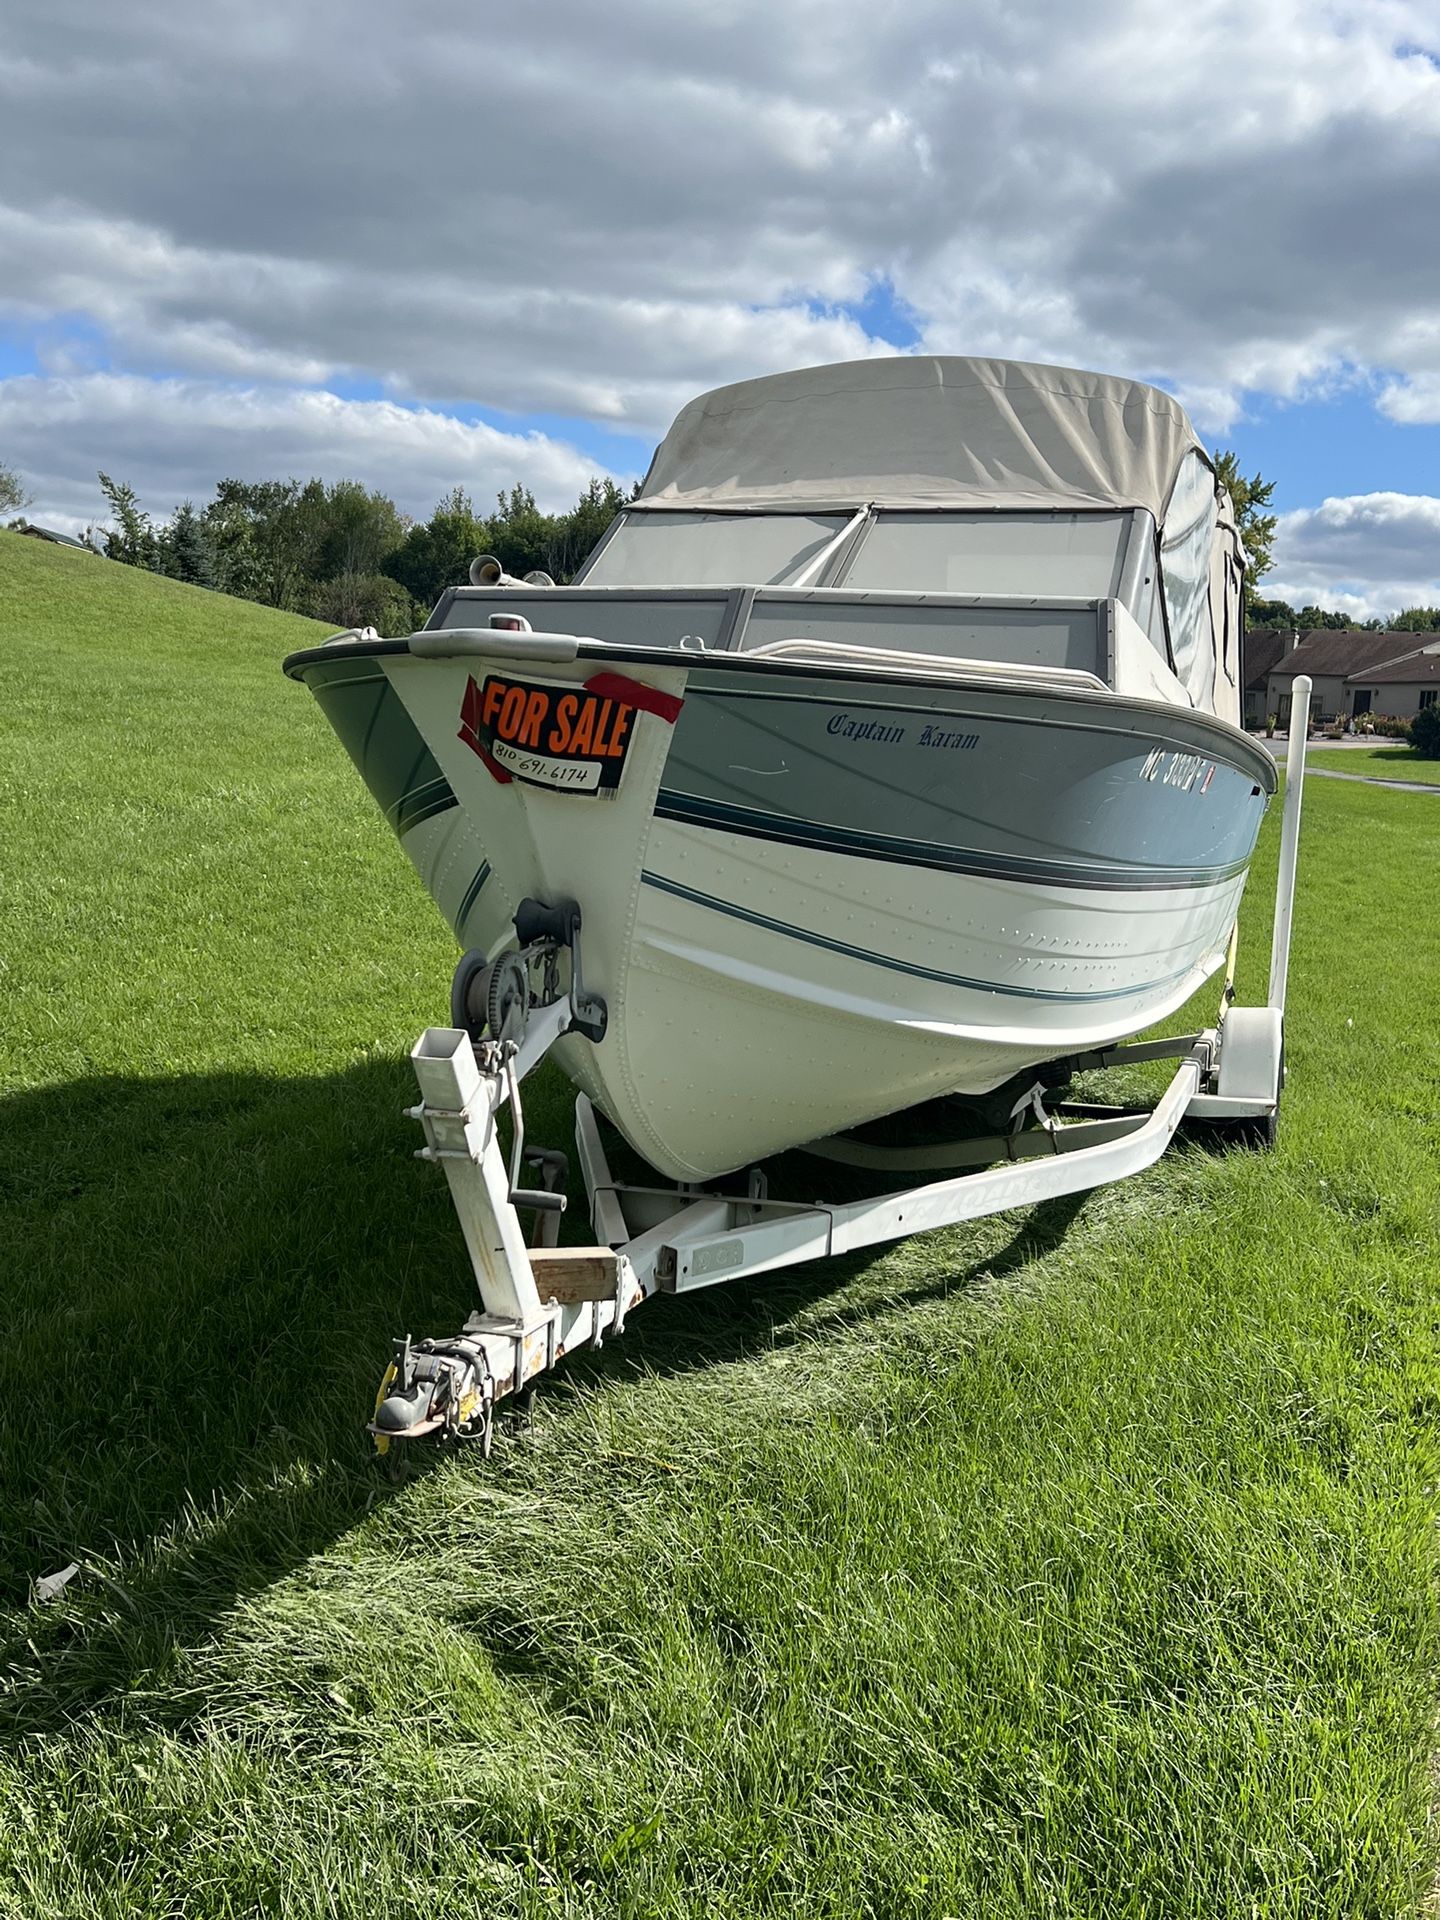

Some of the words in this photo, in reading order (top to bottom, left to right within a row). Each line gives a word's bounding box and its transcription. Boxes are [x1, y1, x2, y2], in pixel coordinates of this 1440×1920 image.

[482, 681, 549, 748] FOR
[549, 695, 633, 757] SALE
[826, 713, 906, 743] Captain
[918, 724, 981, 750] Karam
[1139, 746, 1166, 781] MC
